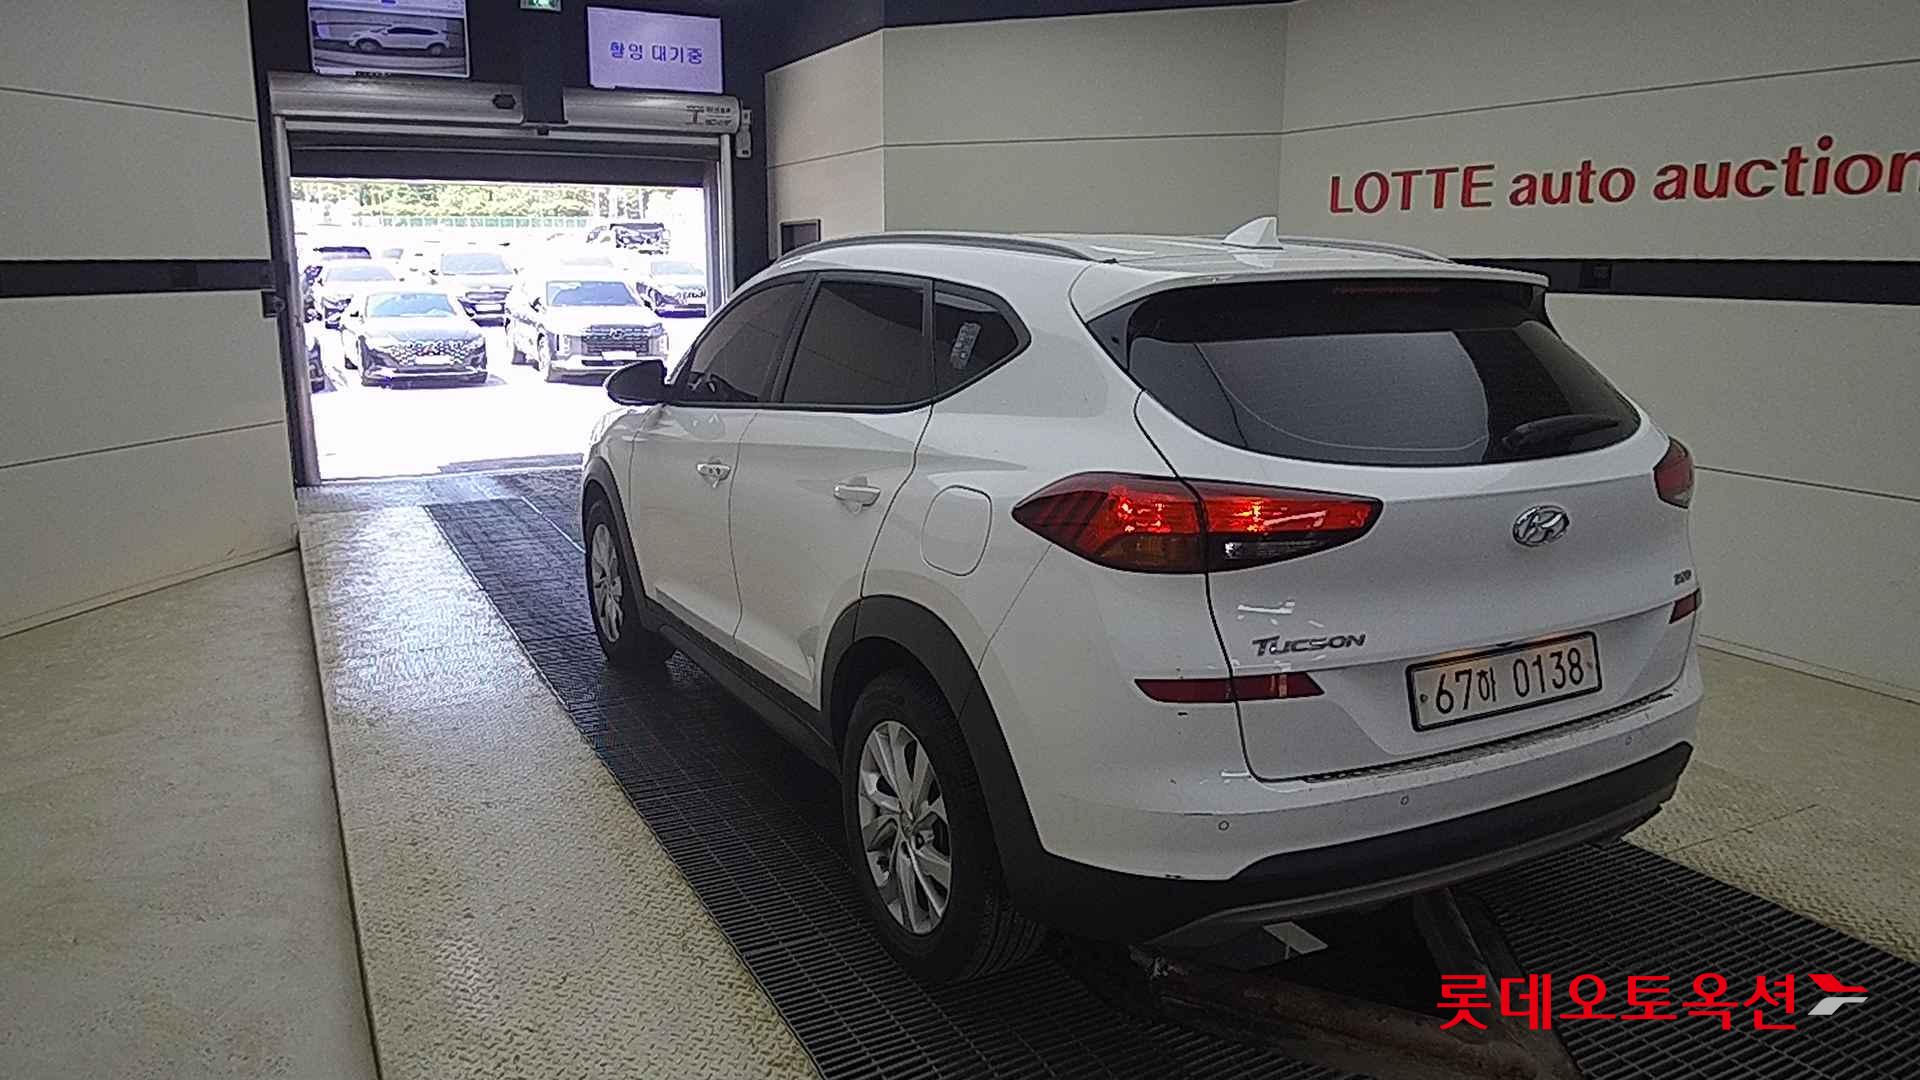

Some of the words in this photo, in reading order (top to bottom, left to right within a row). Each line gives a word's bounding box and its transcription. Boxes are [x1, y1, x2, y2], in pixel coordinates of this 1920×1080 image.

[610, 41, 643, 60] 촬영
[652, 44, 703, 65] 대기중
[1329, 164, 1495, 213] LOTTE
[1509, 160, 1635, 206] auto
[1435, 667, 1497, 714] 67하
[1513, 647, 1584, 697] 0138
